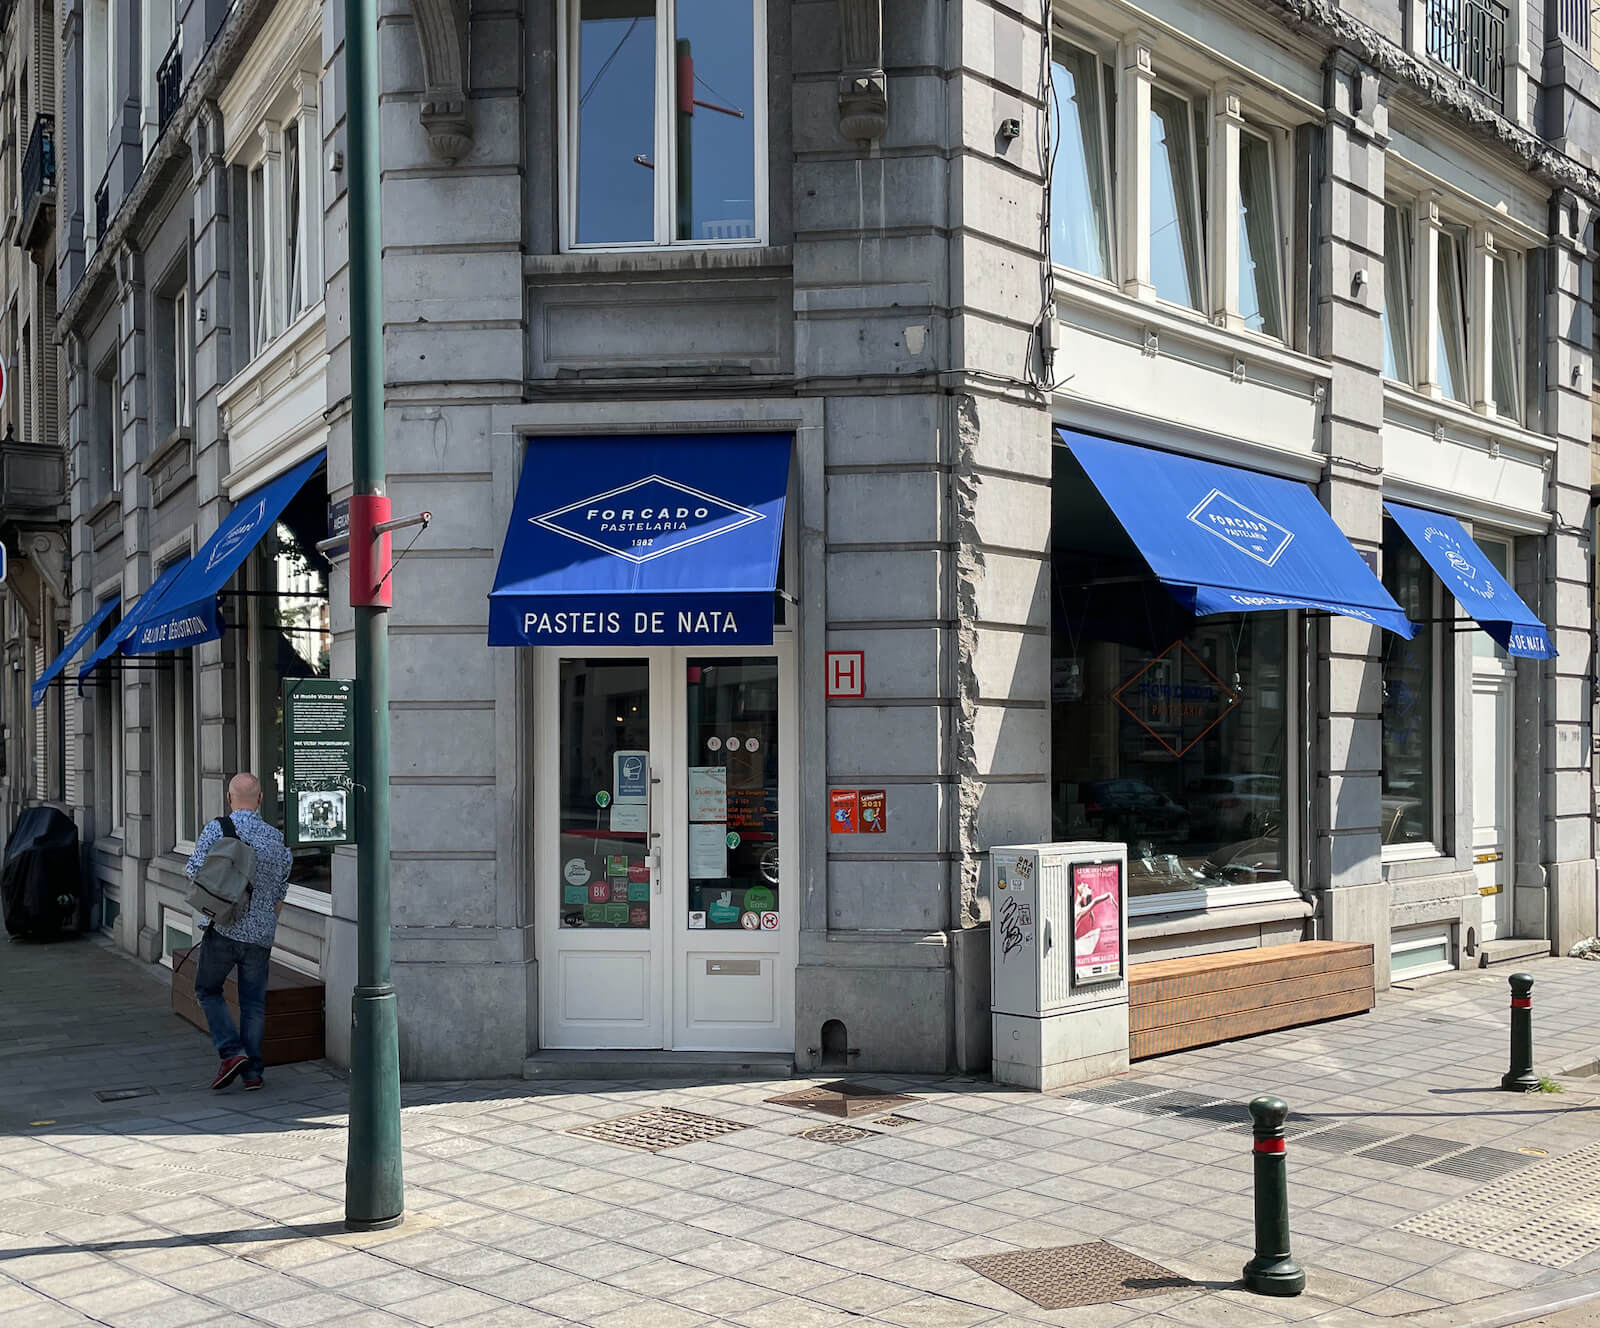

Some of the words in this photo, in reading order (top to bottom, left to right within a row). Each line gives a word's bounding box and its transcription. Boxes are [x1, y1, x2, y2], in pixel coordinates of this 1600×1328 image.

[586, 507, 709, 521] FORCADO
[600, 521, 689, 532] PASTELARIA
[1208, 513, 1268, 532] FORCADO
[631, 537, 654, 547] 1982
[523, 612, 621, 633] PASTEIS
[634, 611, 666, 633] DE
[677, 611, 739, 633] NATA
[1515, 634, 1528, 650] DE
[1526, 635, 1546, 652] NATA
[834, 659, 855, 689] H
[862, 800, 882, 808] 2021
[593, 886, 606, 897] BK
